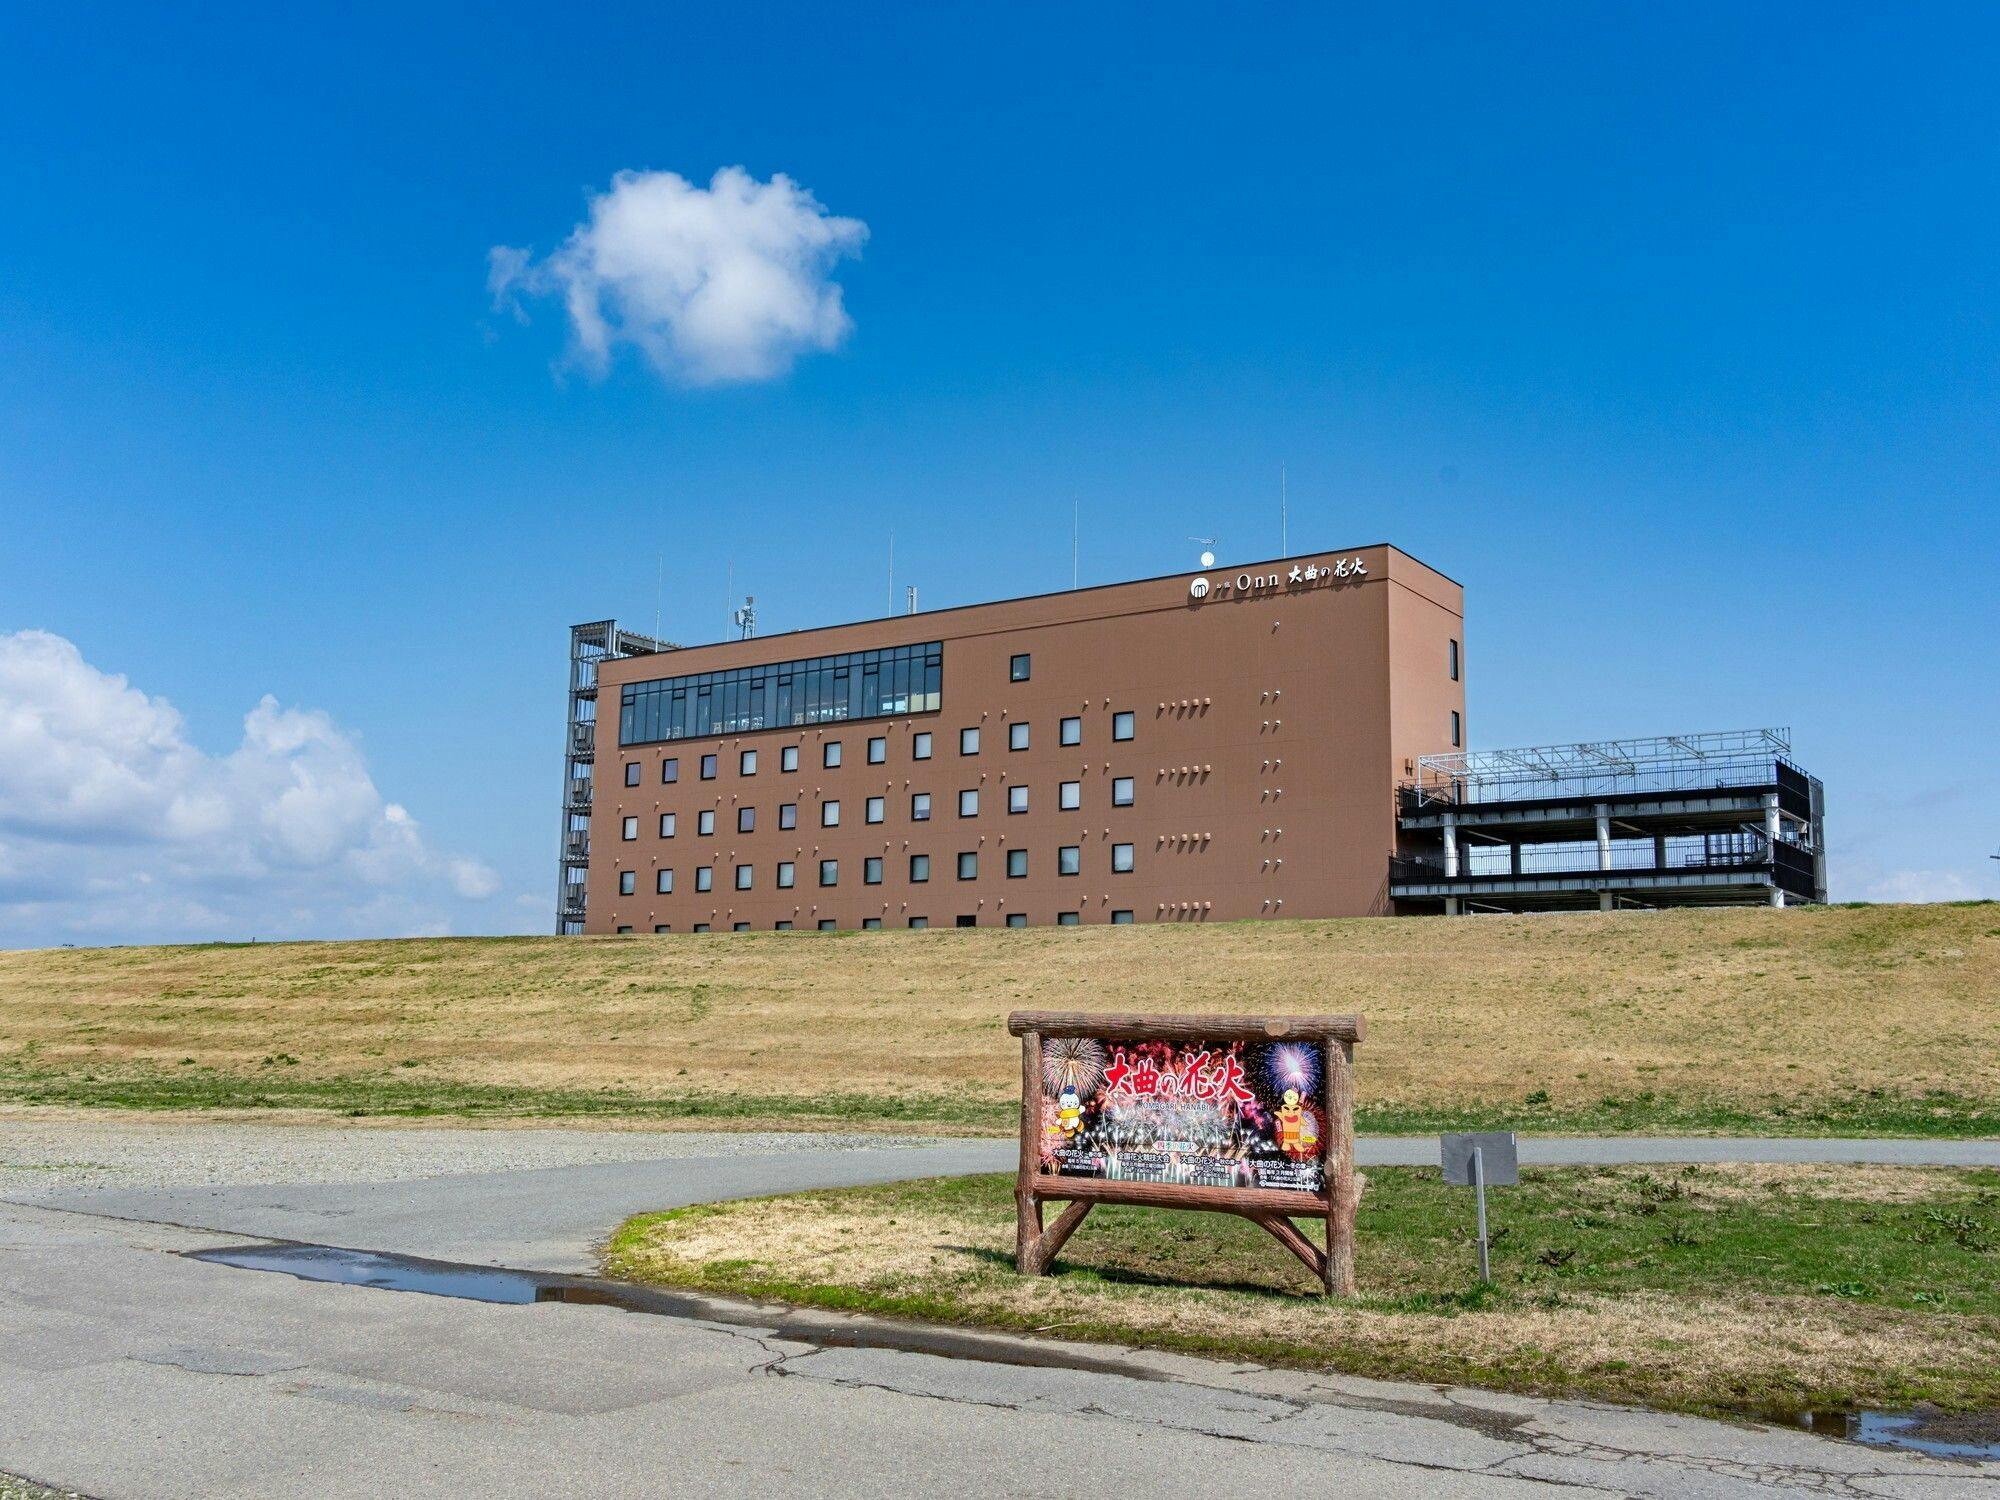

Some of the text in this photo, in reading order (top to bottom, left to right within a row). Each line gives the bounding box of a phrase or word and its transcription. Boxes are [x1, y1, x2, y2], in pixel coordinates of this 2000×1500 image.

[1237, 574, 1279, 590] Onn
[1288, 557, 1368, 584] 大曲の花火
[1104, 1052, 1255, 1102] 大曲の花火
[1143, 1102, 1210, 1112] OMAGARI HANABI
